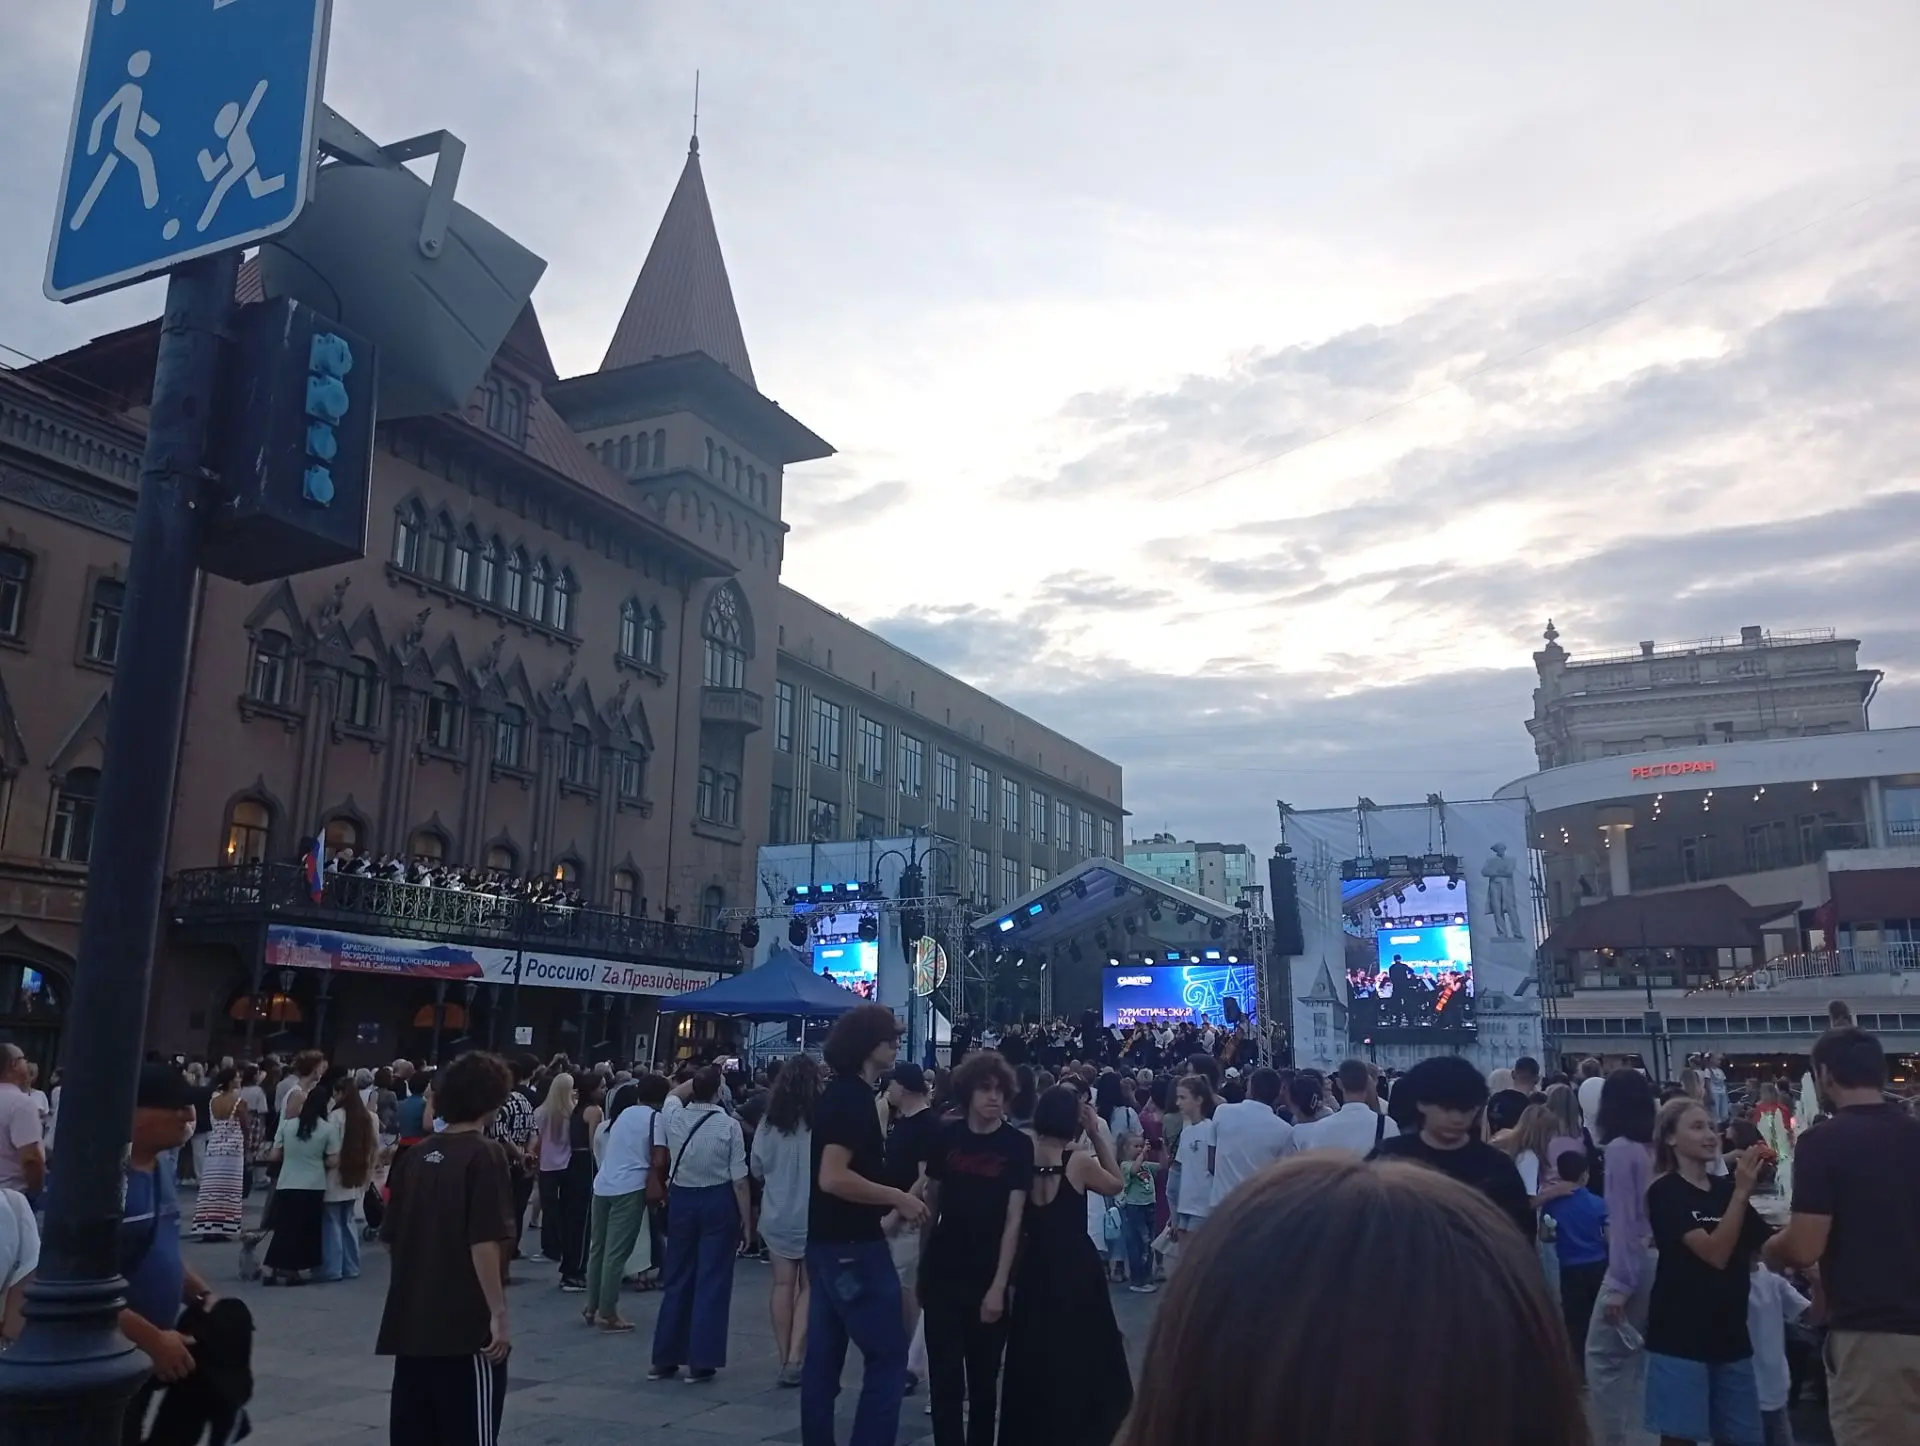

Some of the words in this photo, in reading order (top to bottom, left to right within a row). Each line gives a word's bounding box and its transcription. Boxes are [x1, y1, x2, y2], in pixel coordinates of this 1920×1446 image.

[1631, 761, 1715, 779] РЕСТОРАН
[341, 943, 386, 954] САРАТОВСКАЯ
[340, 951, 400, 963] ГОСУДАРСТВЕННАЯ
[400, 957, 450, 968] КОНСЕРВАТОРИЯ
[525, 958, 596, 982] Россию!
[622, 968, 711, 993] Президента!
